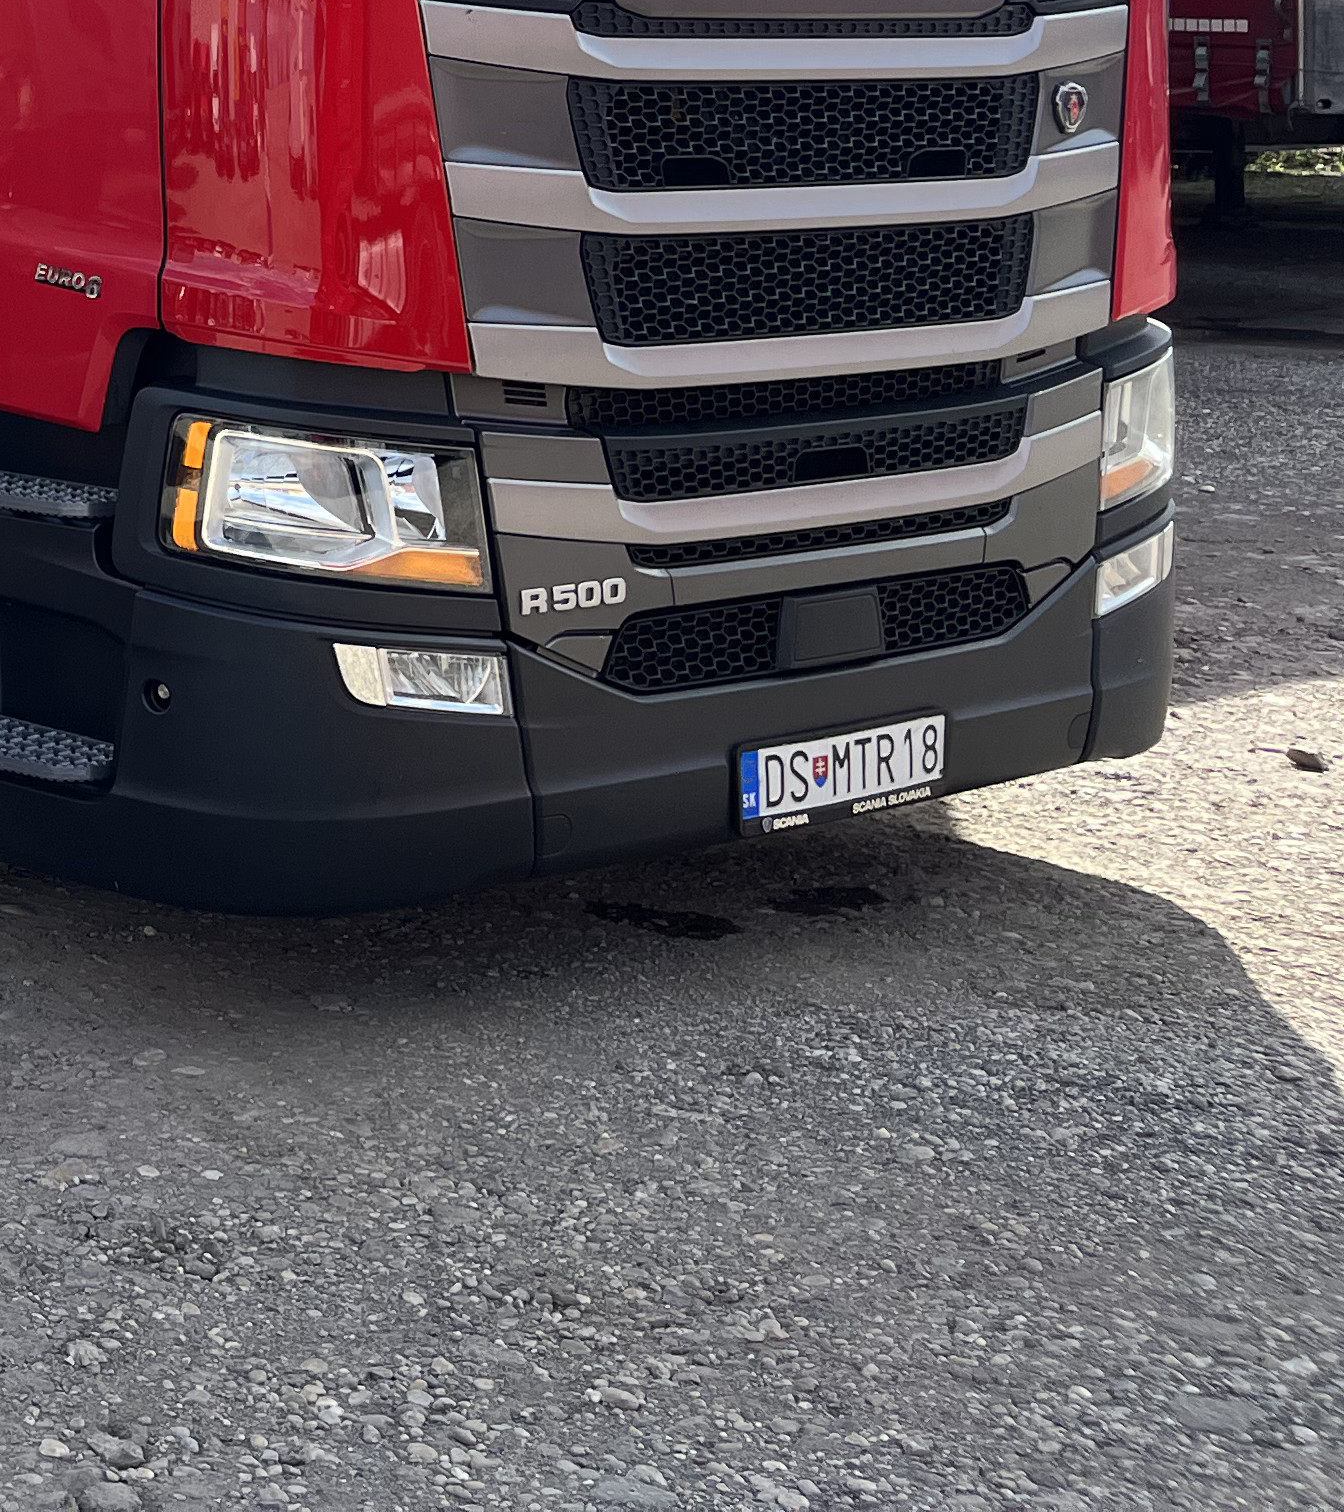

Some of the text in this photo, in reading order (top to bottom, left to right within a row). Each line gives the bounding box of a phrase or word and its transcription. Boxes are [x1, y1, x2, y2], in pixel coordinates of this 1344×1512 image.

[521, 577, 627, 616] R 500
[743, 792, 756, 808] SK
[773, 786, 932, 830] SCANIA SCANIA SLOVAKIA
